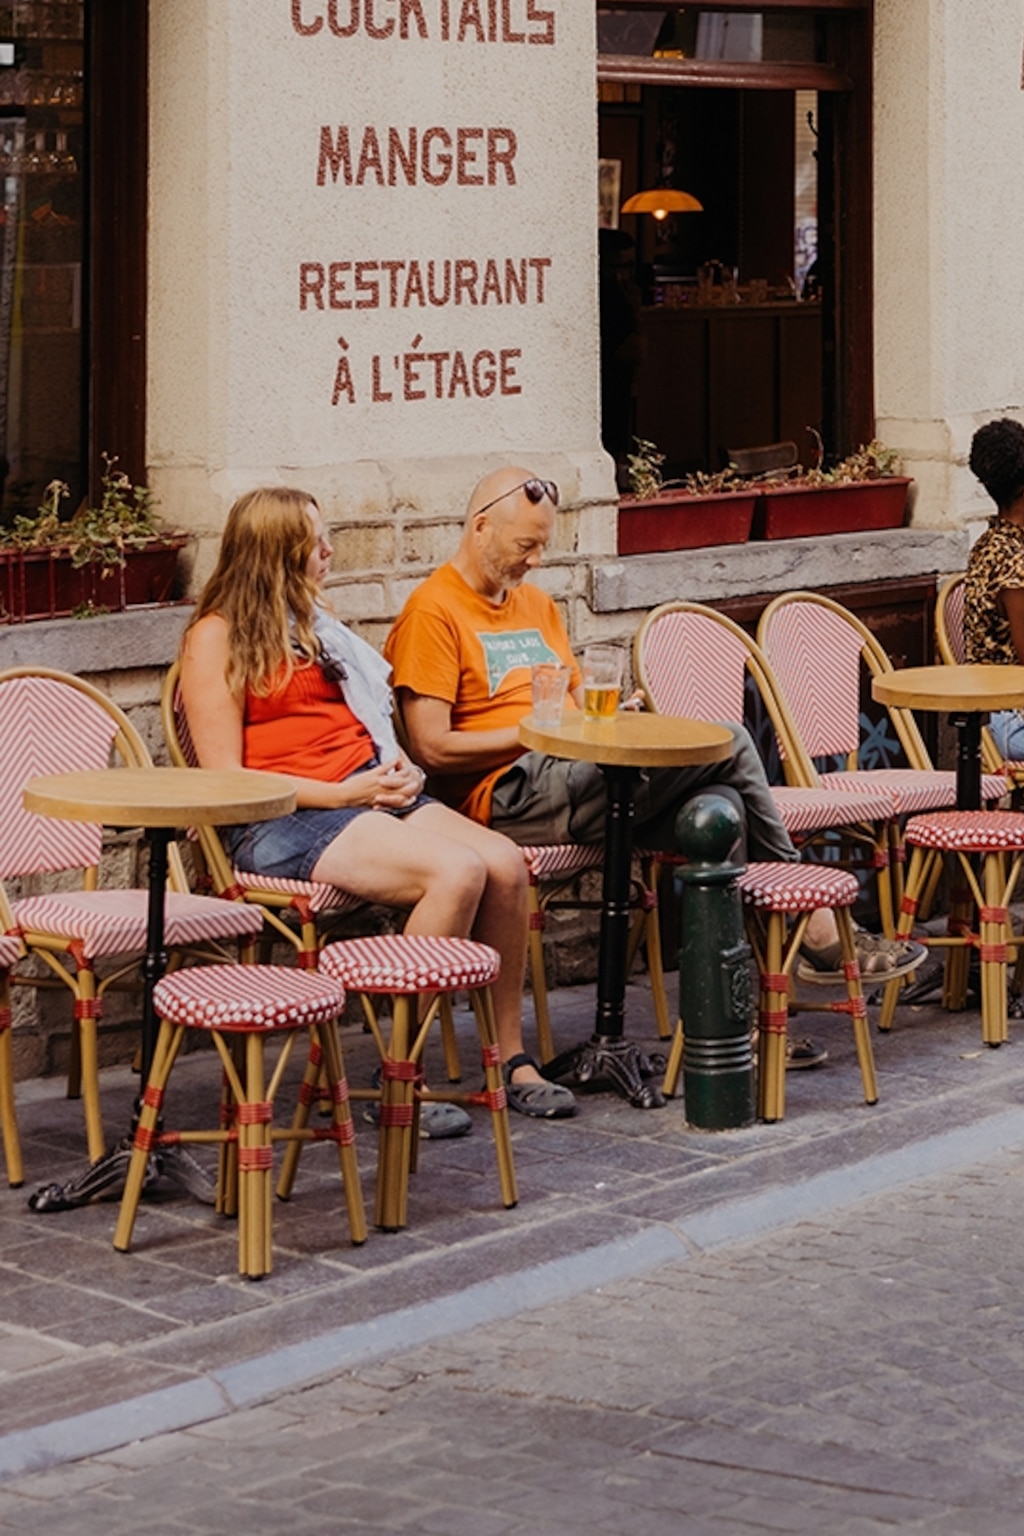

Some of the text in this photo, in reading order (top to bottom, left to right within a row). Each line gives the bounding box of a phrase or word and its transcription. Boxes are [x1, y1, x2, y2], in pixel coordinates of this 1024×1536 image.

[316, 125, 518, 187] MANGER
[299, 257, 553, 311] RESTAURANT
[331, 333, 522, 407] À L'ÉTAGE
